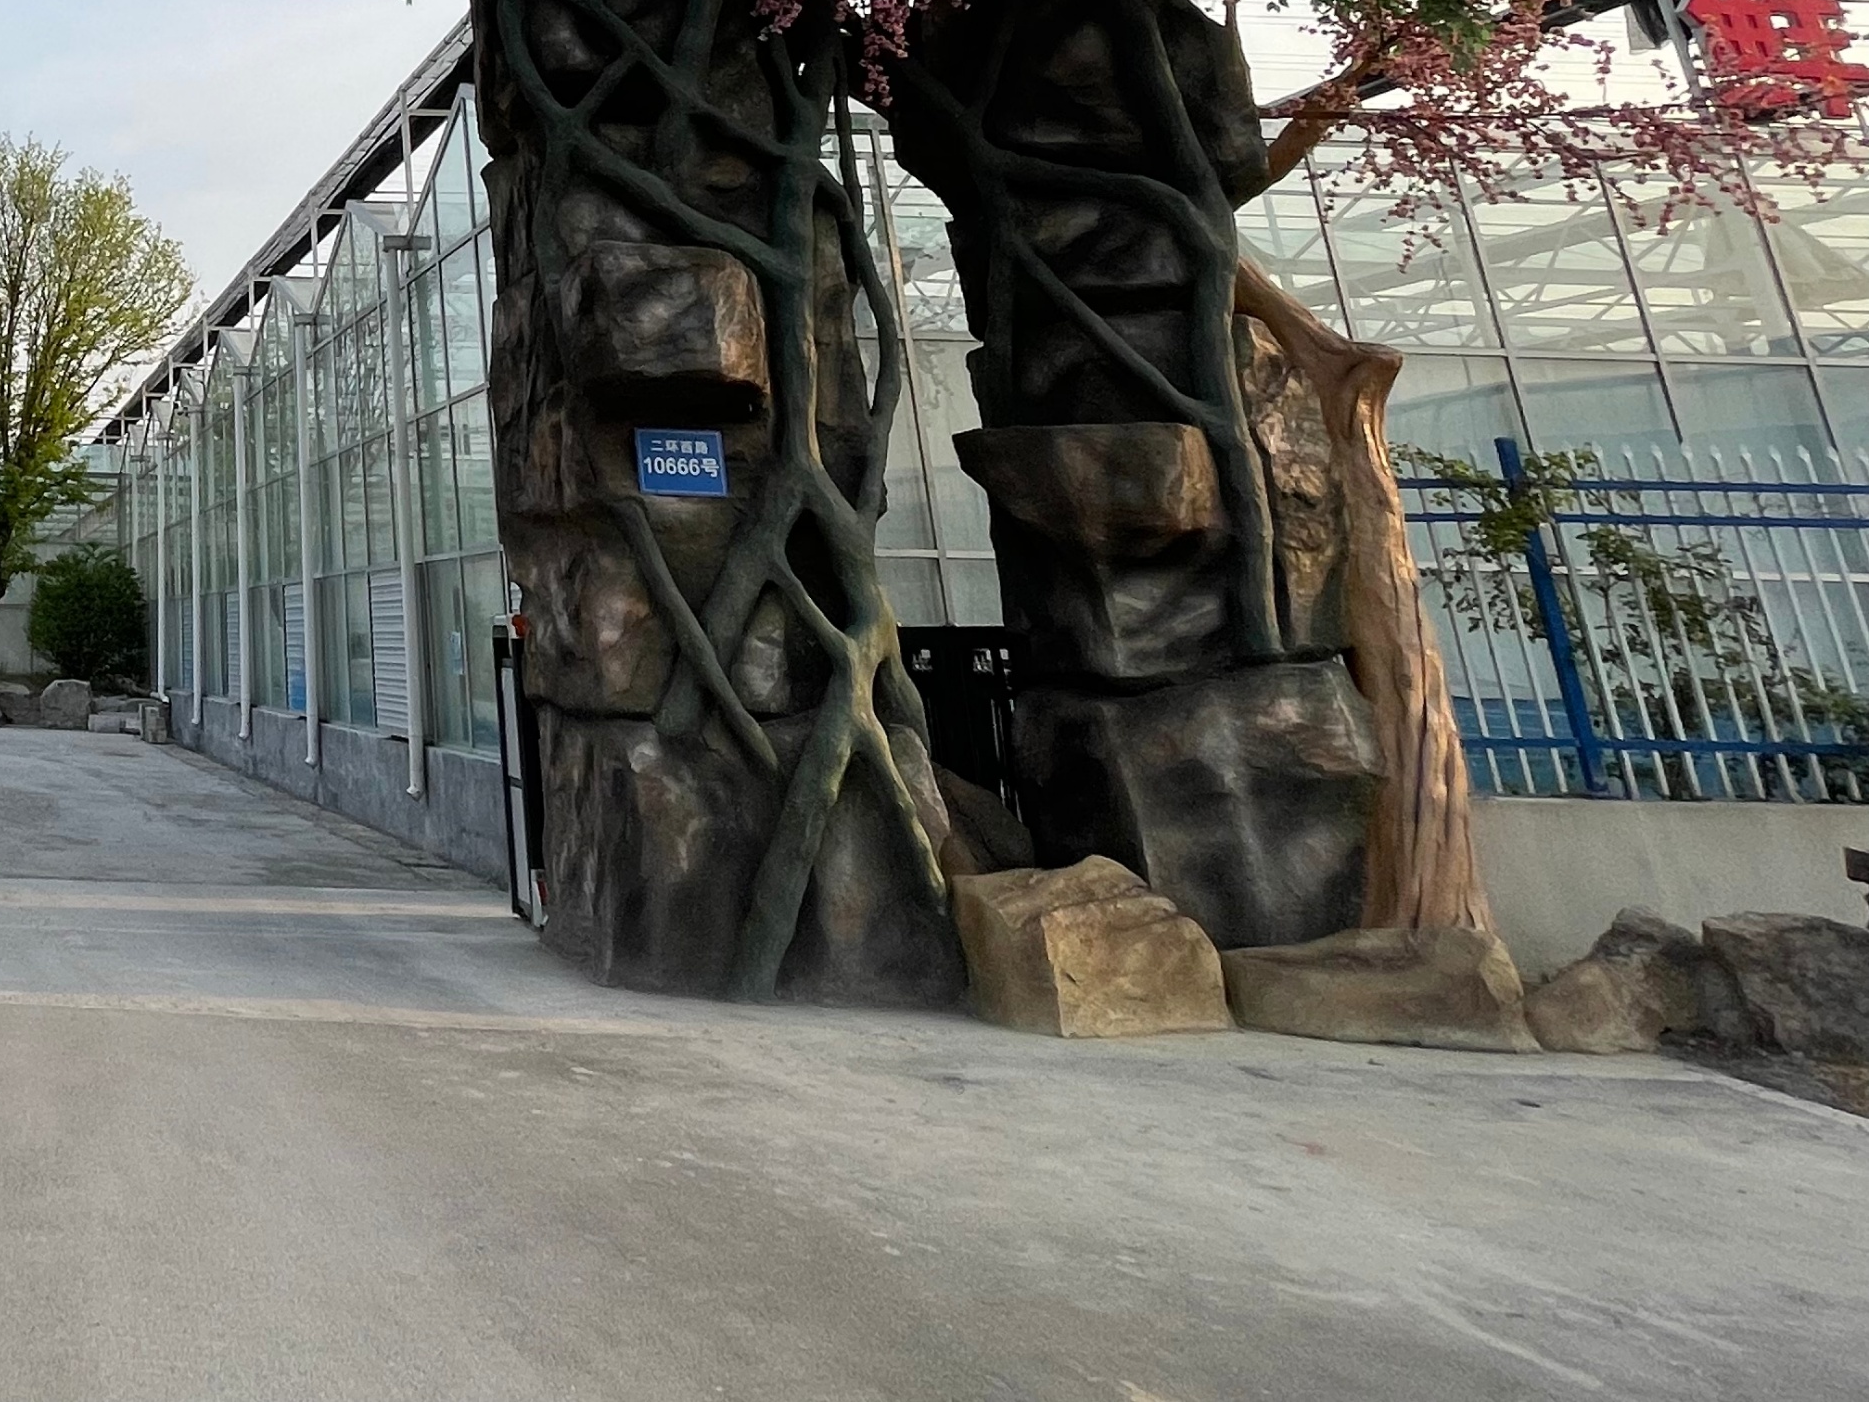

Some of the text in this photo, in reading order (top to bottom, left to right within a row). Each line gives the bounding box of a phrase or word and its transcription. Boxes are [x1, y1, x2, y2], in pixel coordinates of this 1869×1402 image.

[650, 439, 708, 454] 二环西路
[643, 456, 720, 478] 10666号
